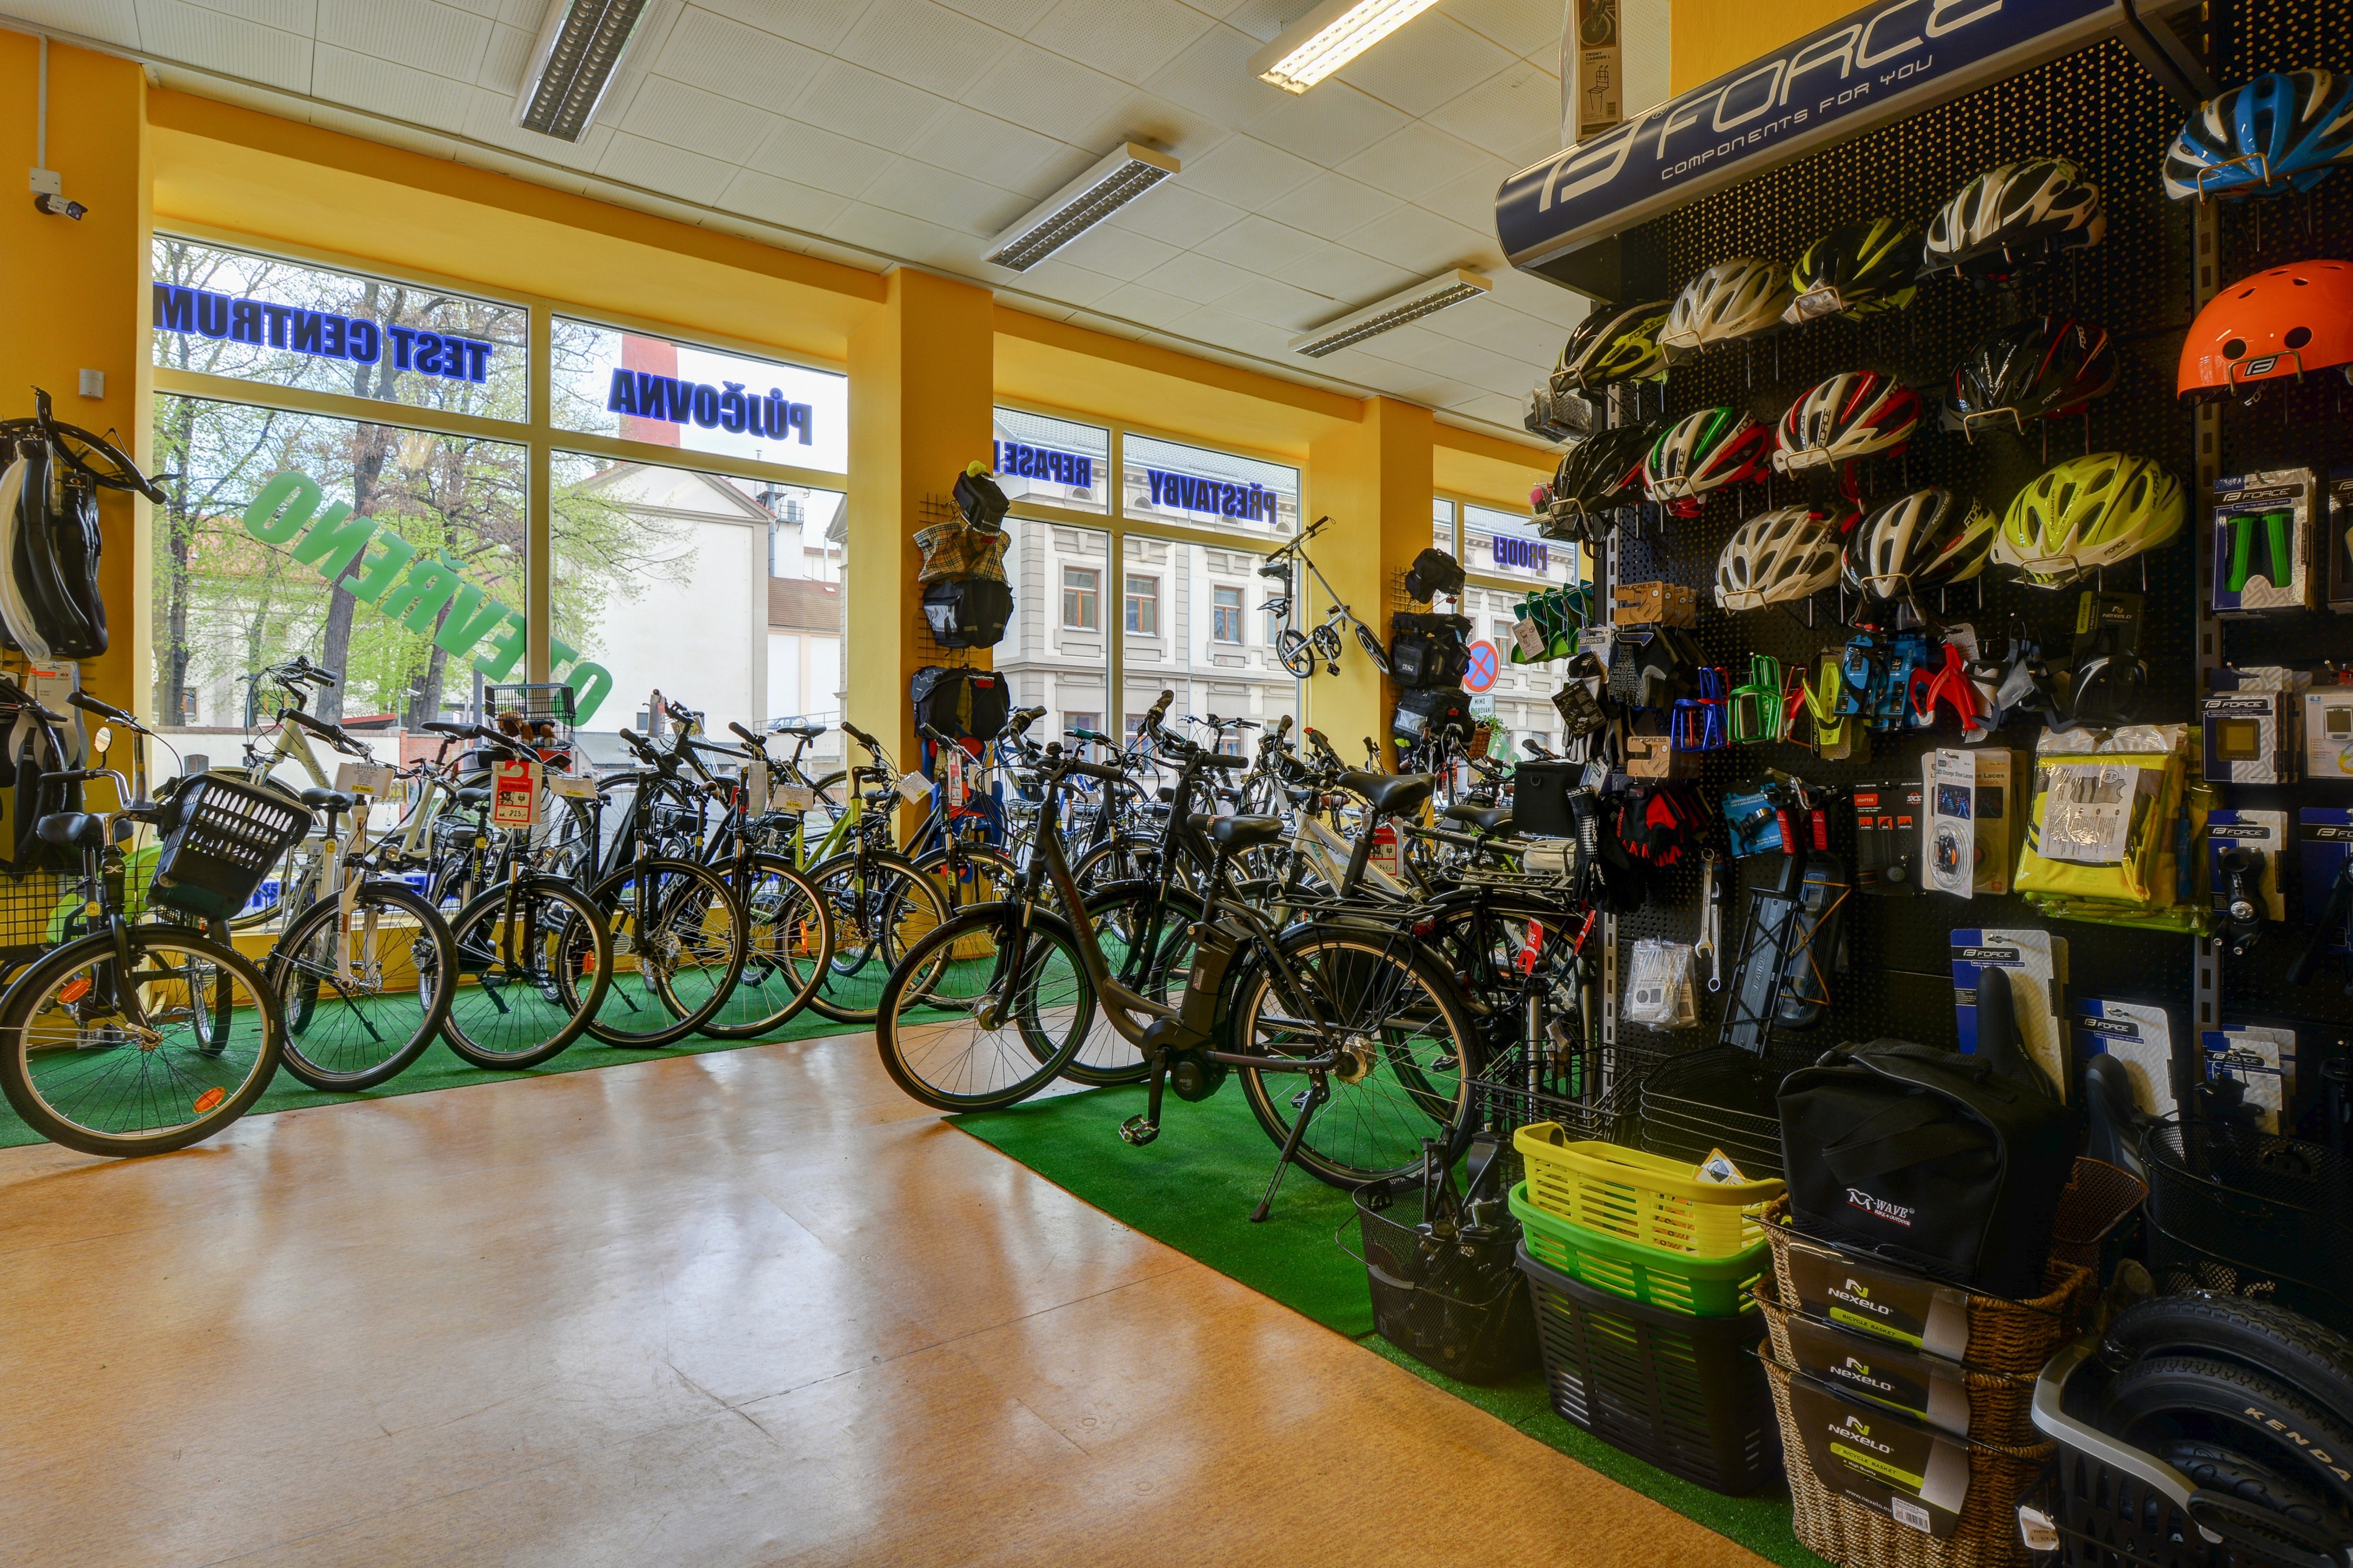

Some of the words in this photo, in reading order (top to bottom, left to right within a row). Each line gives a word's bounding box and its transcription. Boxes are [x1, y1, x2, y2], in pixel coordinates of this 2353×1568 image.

[1657, 0, 2001, 159] FORCE
[1662, 109, 1808, 180] COMPONENTS
[1819, 84, 1869, 113] FOR
[1879, 55, 1933, 85] YOU
[1629, 321, 1657, 342] FORCE
[1729, 318, 1747, 332] FORCE
[2041, 388, 2062, 405] FORCE
[1818, 408, 1831, 448] FORCE
[1674, 448, 1687, 486] FORCE
[2242, 488, 2291, 499] FORCE
[2104, 539, 2127, 556] FORCE
[1059, 886, 1086, 943] KALKHOFF
[2098, 1022, 2129, 1032] FORCE
[2226, 1055, 2258, 1065] FORCE
[1847, 1188, 1909, 1219] M-WAVE
[1828, 1287, 1890, 1315] NEXELO
[1842, 1313, 1868, 1327] BICYCLE
[1870, 1323, 1896, 1337] BASKET
[1830, 1366, 1892, 1392] NEXELO
[1828, 1424, 1890, 1453] NEXELO
[2244, 1406, 2352, 1482] KENDA
[1842, 1449, 1869, 1463] BICYCLE
[1871, 1461, 1897, 1475] BASKET
[1848, 1461, 1859, 1469] High
[1860, 1465, 1876, 1476] Quality
[1845, 1489, 1892, 1513] www.nexelo.eu
